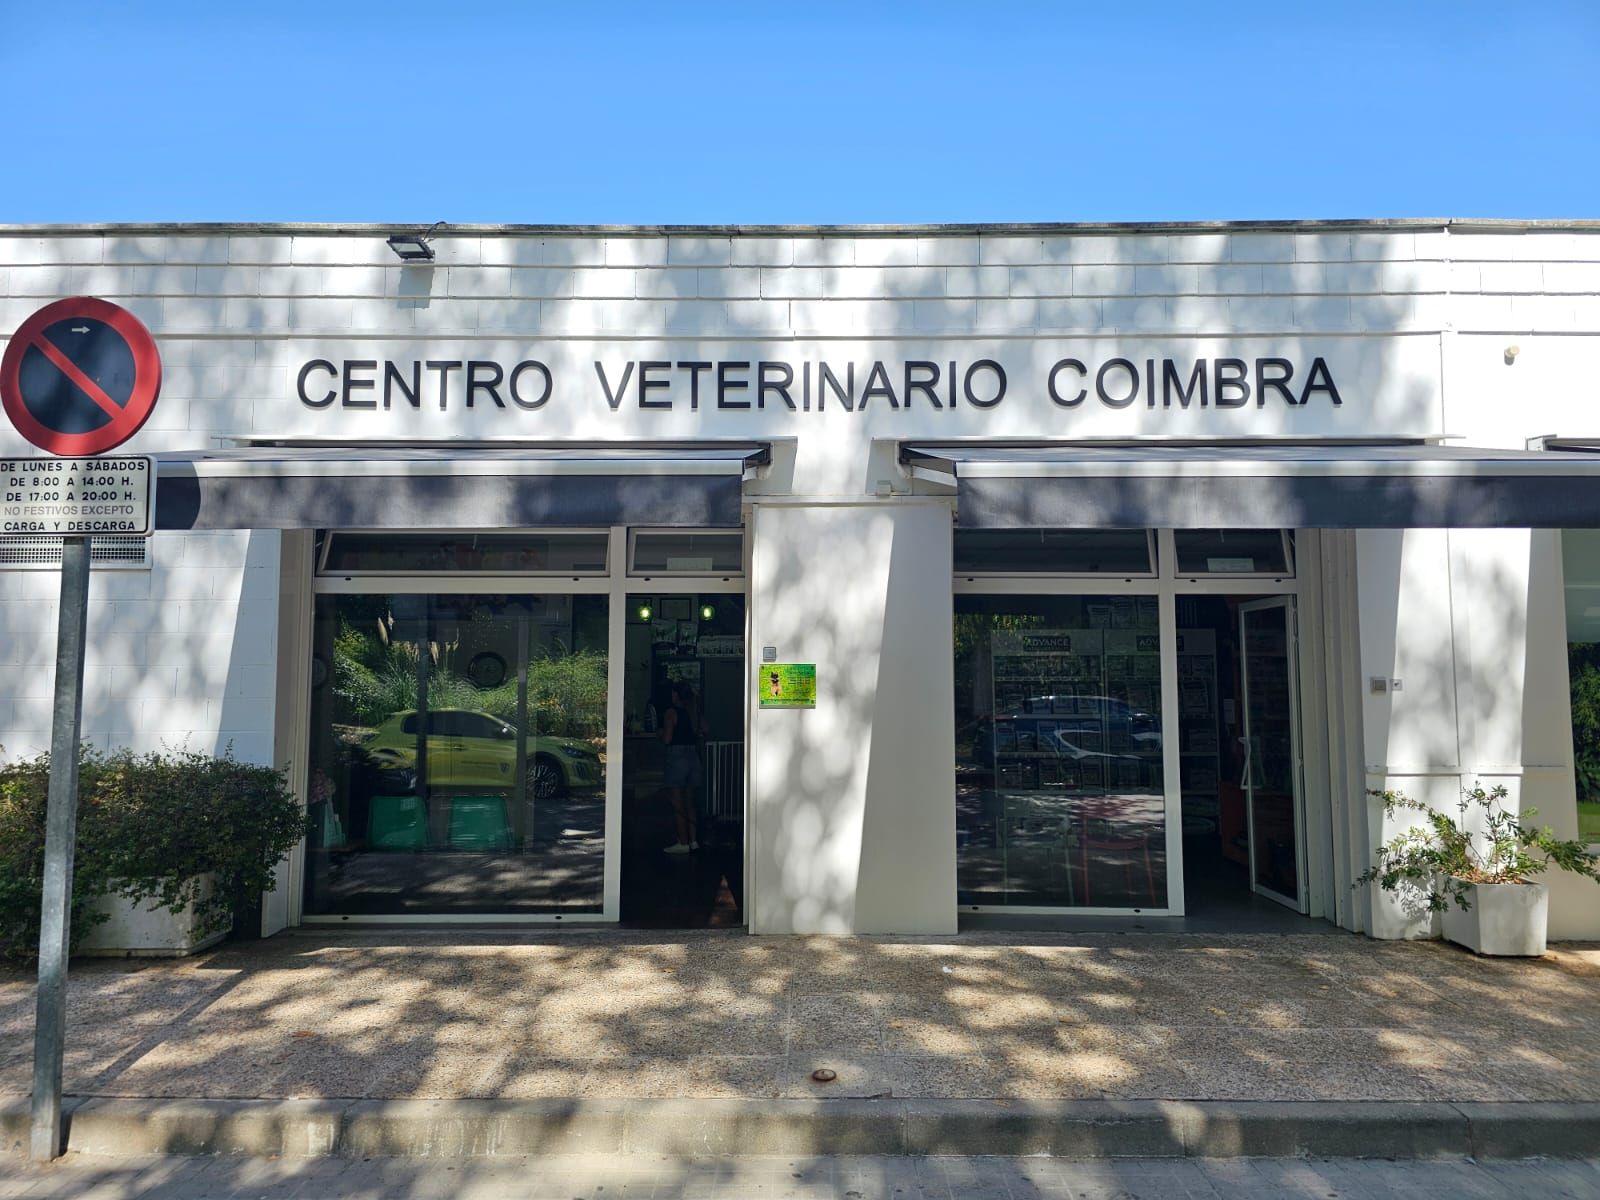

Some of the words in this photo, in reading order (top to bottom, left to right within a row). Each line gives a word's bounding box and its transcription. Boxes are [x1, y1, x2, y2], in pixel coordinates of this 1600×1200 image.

[297, 359, 553, 409] CENTRO
[594, 359, 1008, 412] VETERINARIO
[1047, 356, 1343, 409] COIMBRA
[0, 463, 16, 472] DE
[22, 462, 63, 472] LUNES
[70, 462, 78, 472] A
[10, 478, 26, 487] DE
[32, 477, 60, 487] 8:00
[66, 477, 75, 486] A
[82, 476, 115, 486] 14:00
[121, 476, 134, 486] H.
[6, 492, 22, 502] DE
[29, 492, 60, 501] 17:00
[66, 491, 75, 501] A
[81, 491, 118, 501] 20:00
[124, 491, 137, 501] H.
[4, 506, 20, 516] NO
[23, 505, 78, 516] FESTIVOS
[81, 505, 134, 515] EXCEPTO
[4, 521, 45, 531] CARGA
[53, 521, 60, 531] Y
[67, 521, 136, 531] DESCARGA
